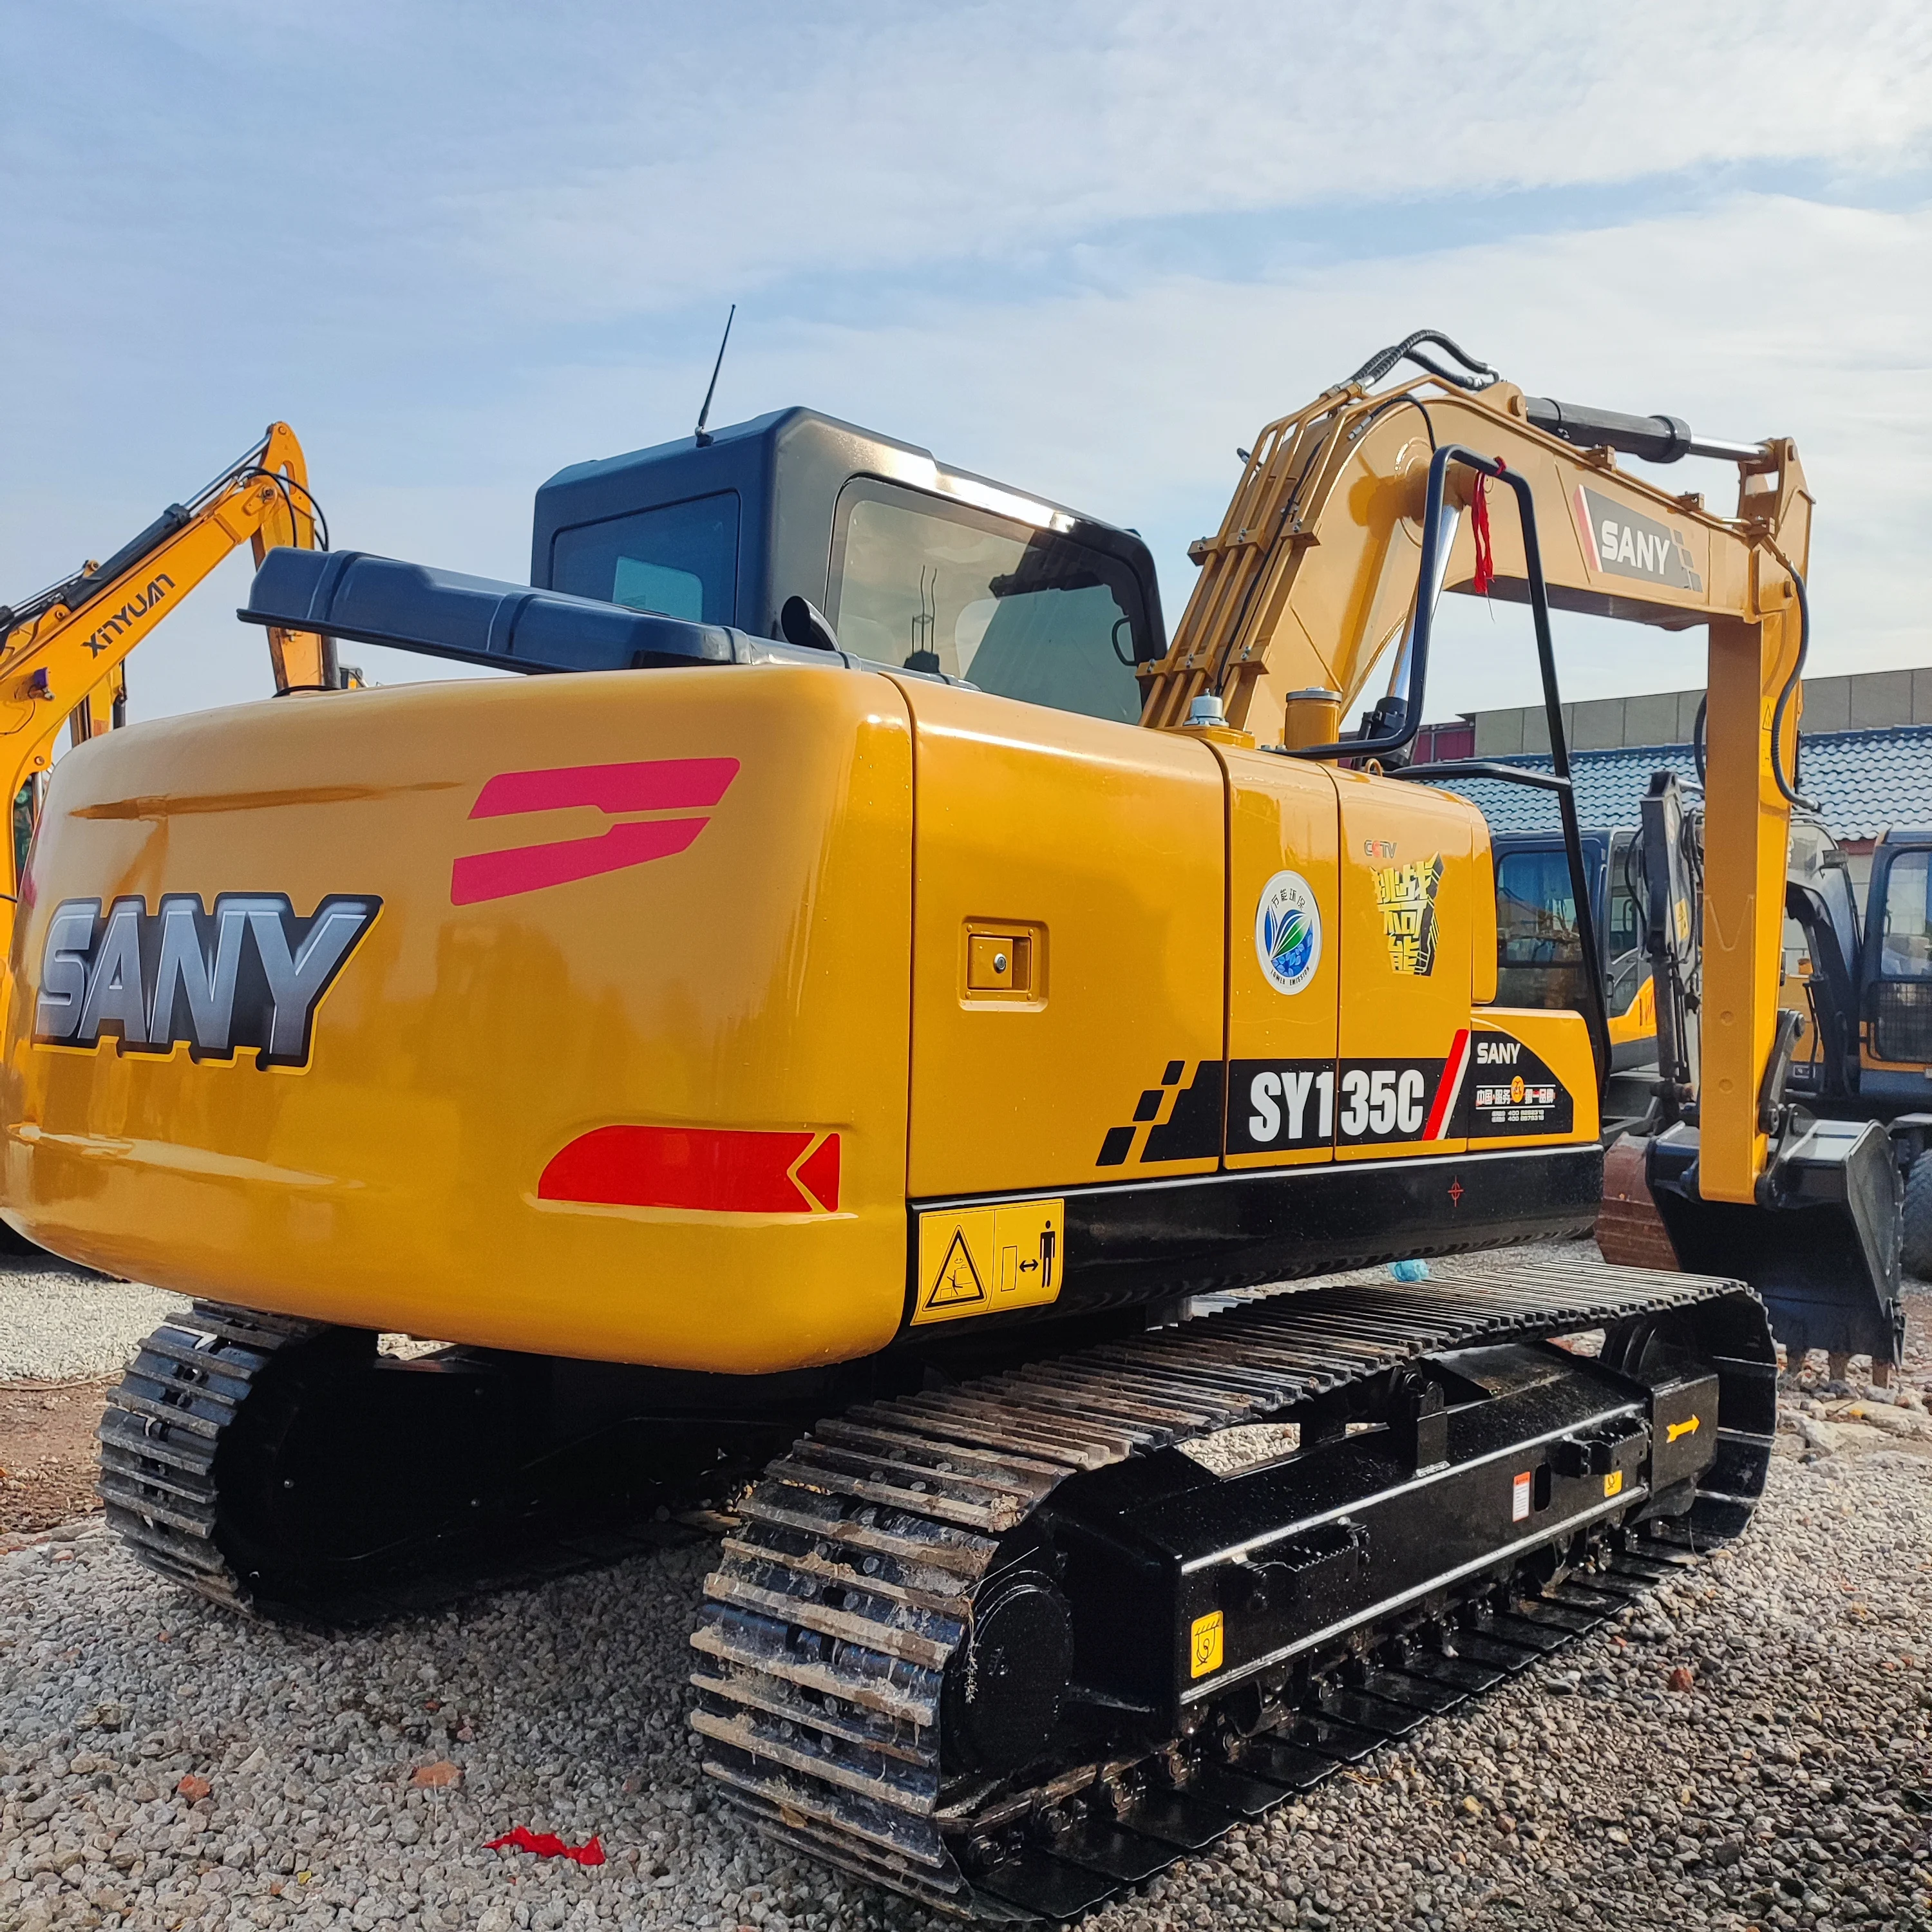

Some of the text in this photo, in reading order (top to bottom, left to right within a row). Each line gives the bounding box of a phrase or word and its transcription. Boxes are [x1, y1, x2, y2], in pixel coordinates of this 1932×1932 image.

[1601, 519, 1671, 575] SANY
[1363, 839, 1397, 859] CCTV
[33, 895, 375, 1064] SANY
[1477, 1042, 1520, 1065] SANY
[1248, 1069, 1425, 1142] SY135C
